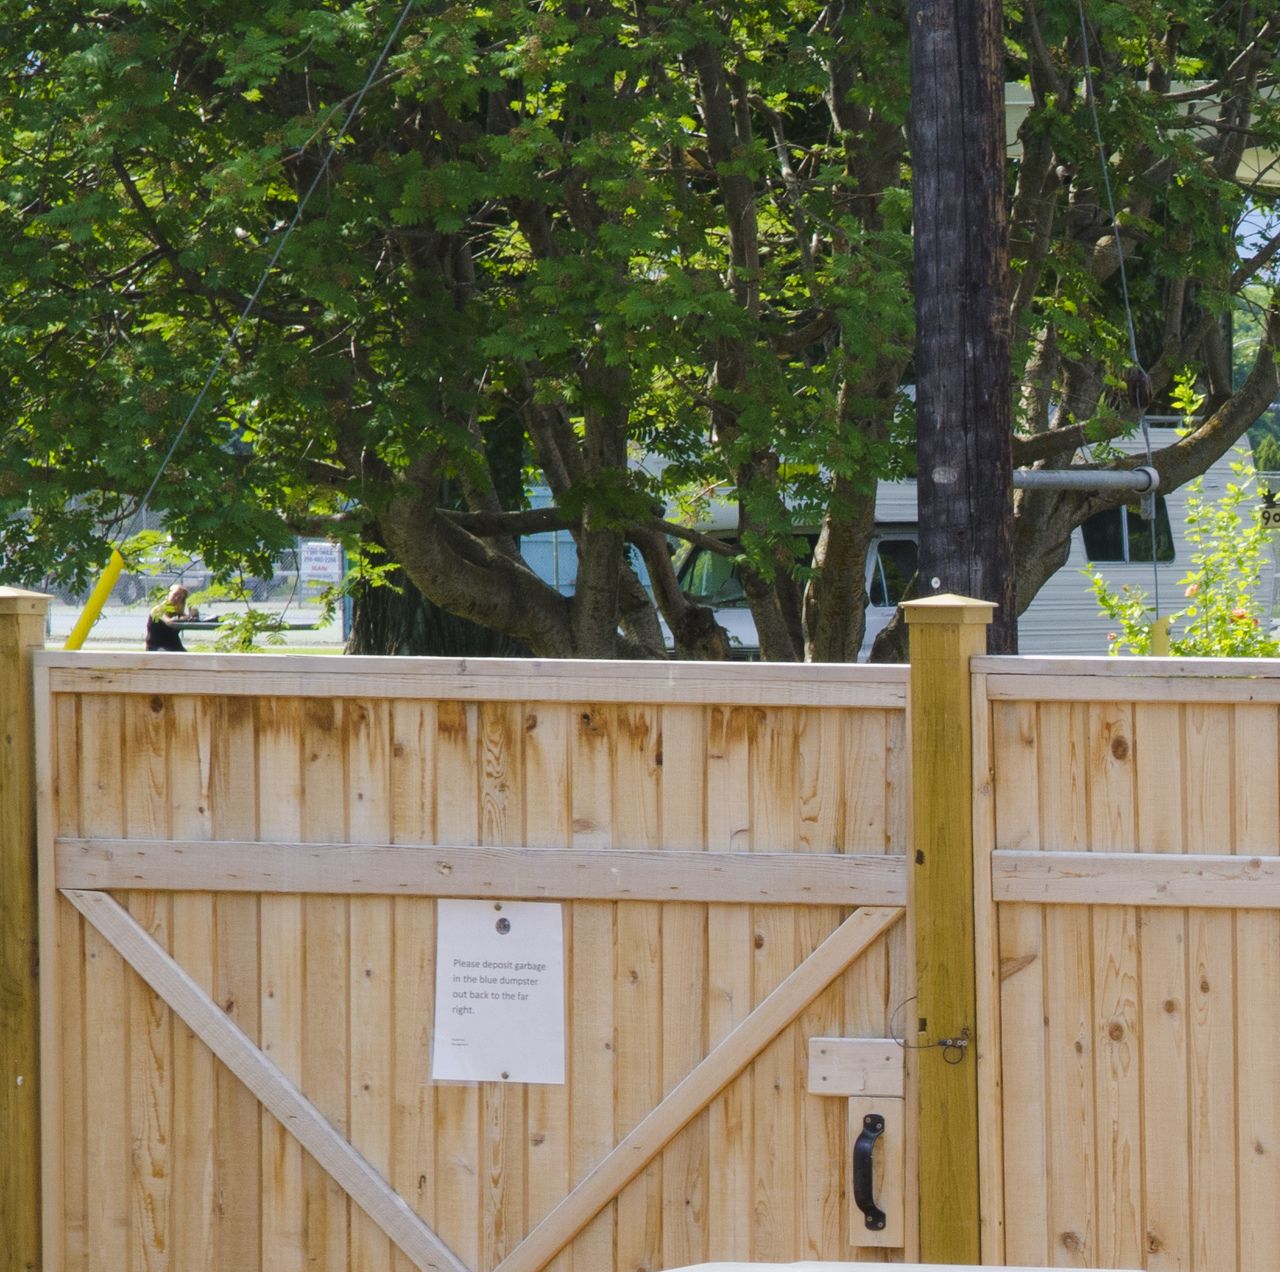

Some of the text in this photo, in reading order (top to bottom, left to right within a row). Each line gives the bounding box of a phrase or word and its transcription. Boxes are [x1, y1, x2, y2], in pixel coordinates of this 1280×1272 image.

[453, 959, 546, 972] Please deposit garbage
[453, 975, 539, 986] in the blue dumpster
[452, 991, 529, 1000] out back to the far
[452, 1006, 475, 1016] right.
